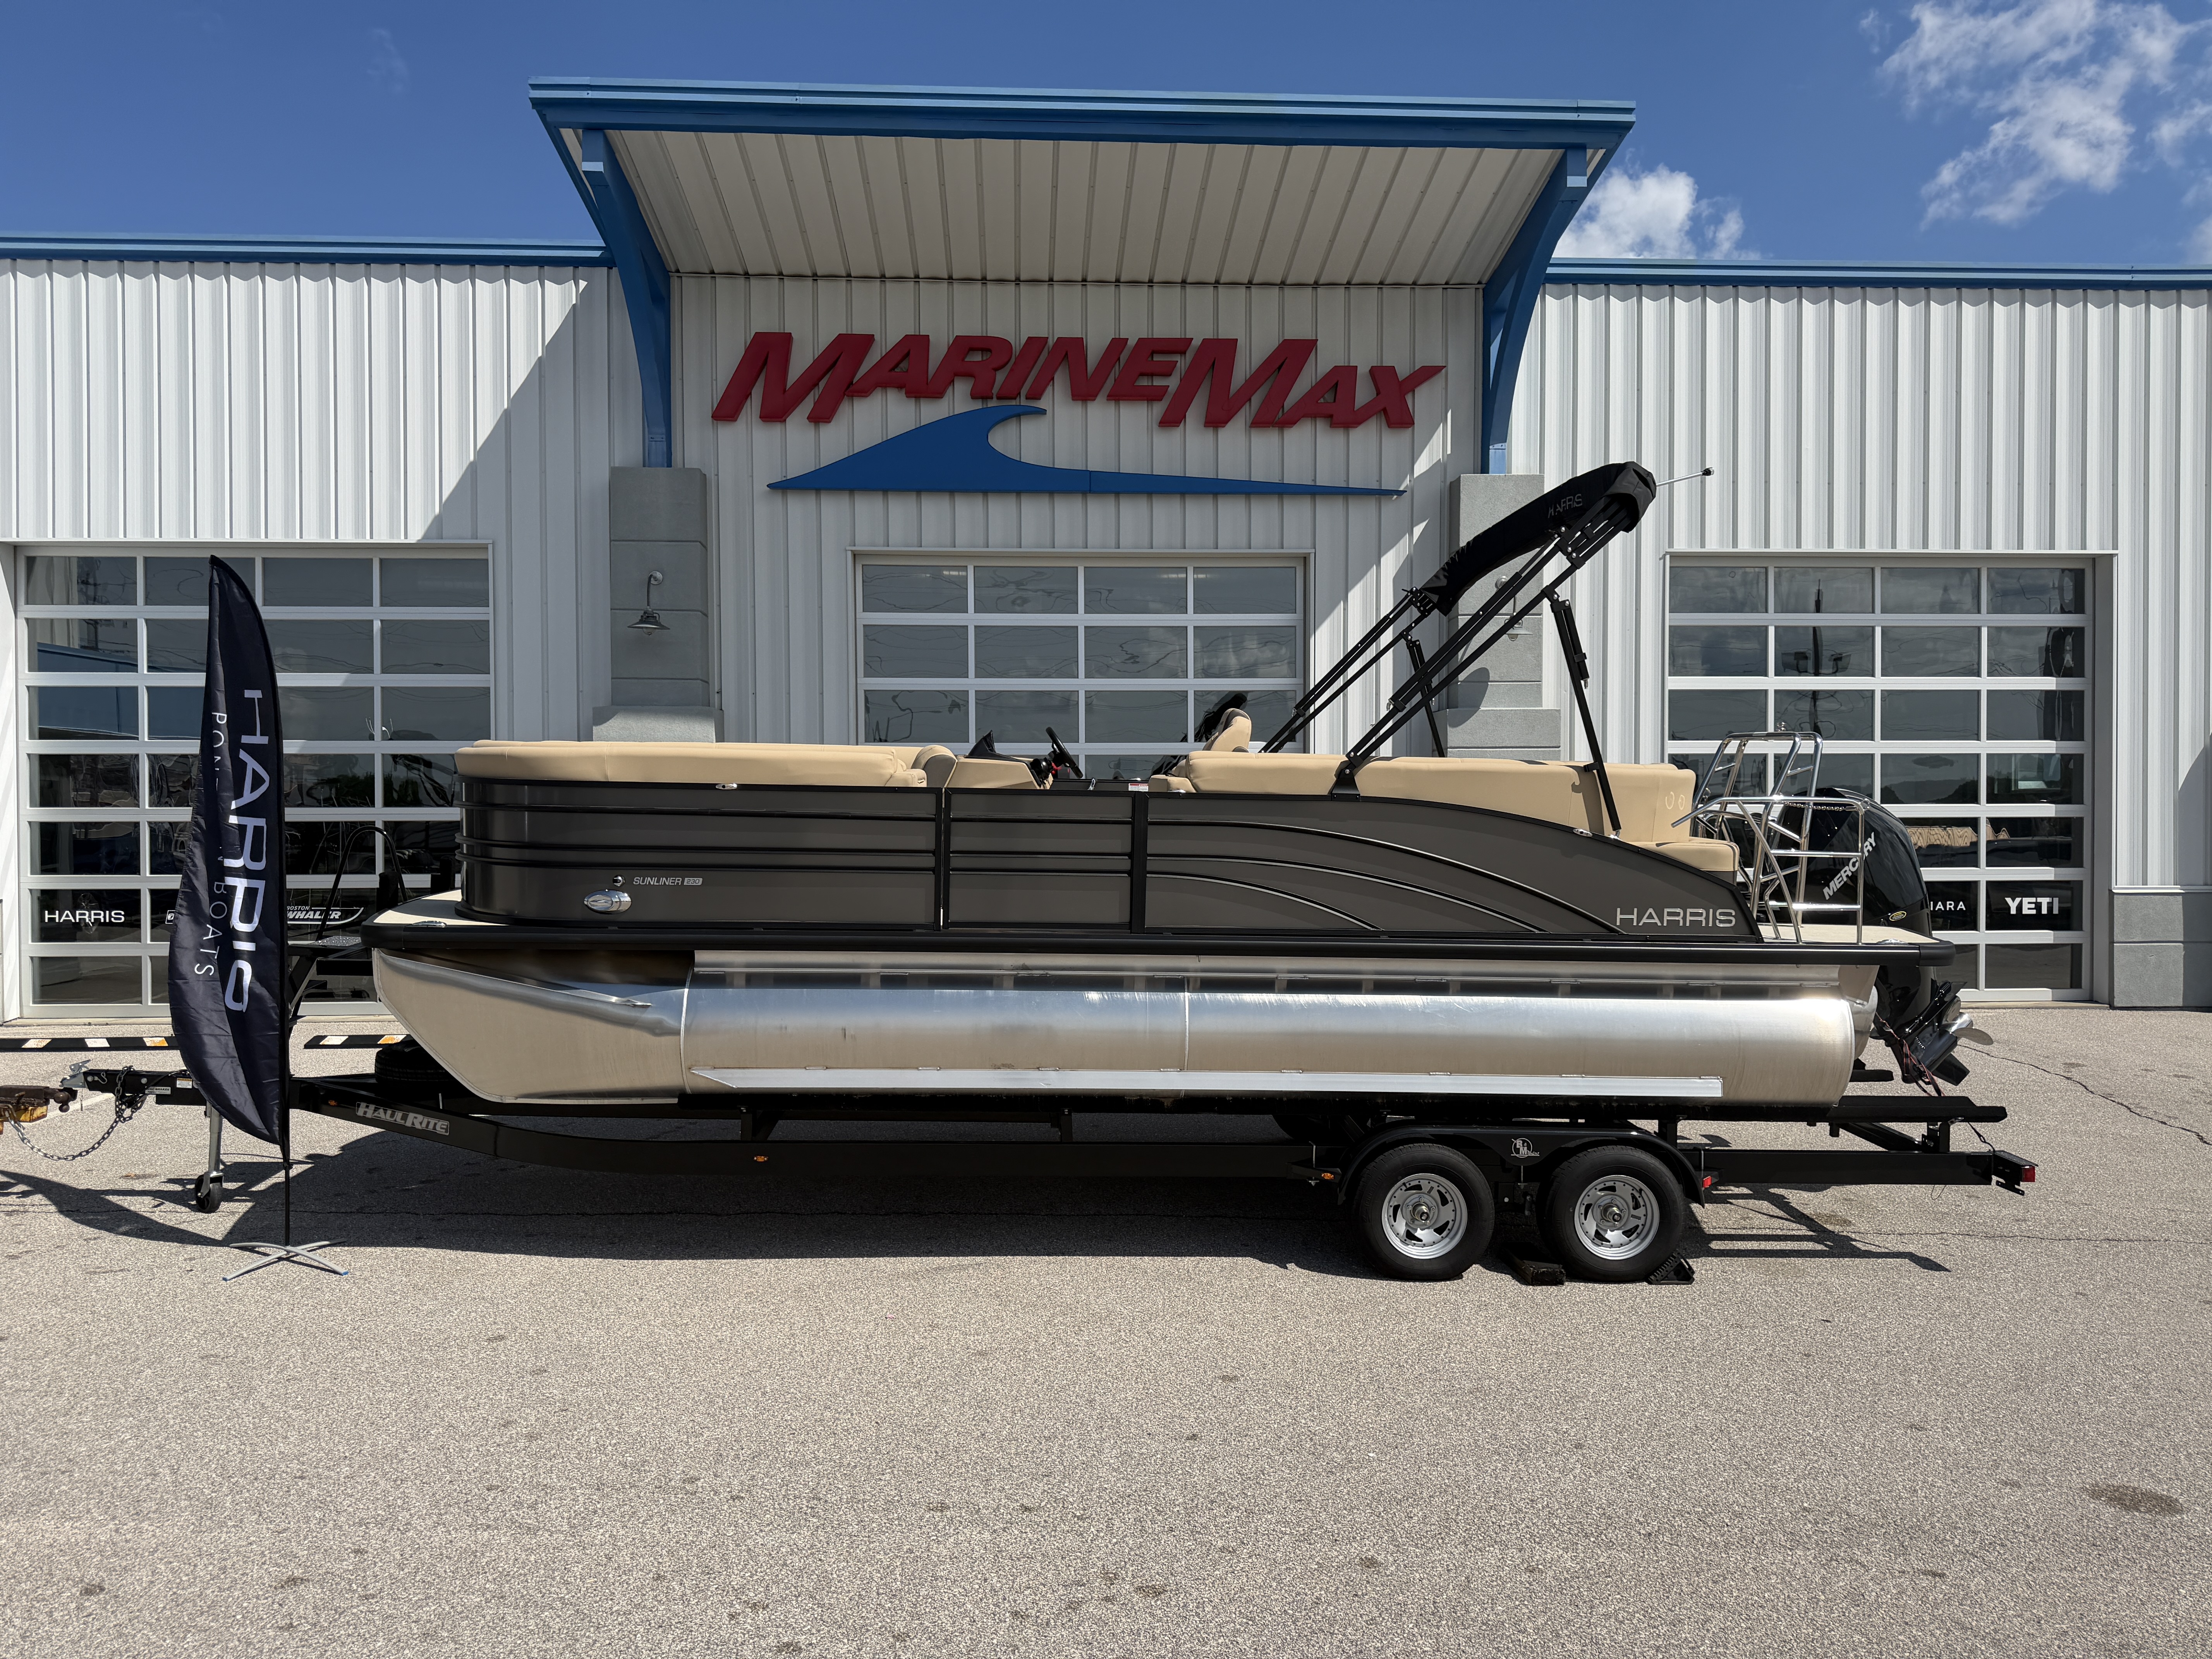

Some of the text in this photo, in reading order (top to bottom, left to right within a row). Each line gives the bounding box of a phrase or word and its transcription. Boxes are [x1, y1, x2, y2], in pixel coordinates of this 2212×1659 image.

[1823, 831, 1876, 900] MERCRY
[633, 877, 682, 885] SUNLINER
[1930, 901, 1966, 911] IARA
[2004, 897, 2059, 914] YETI
[45, 910, 125, 922] HARRIS
[1616, 908, 1736, 927] HARRIS
[194, 882, 227, 975] BOATS
